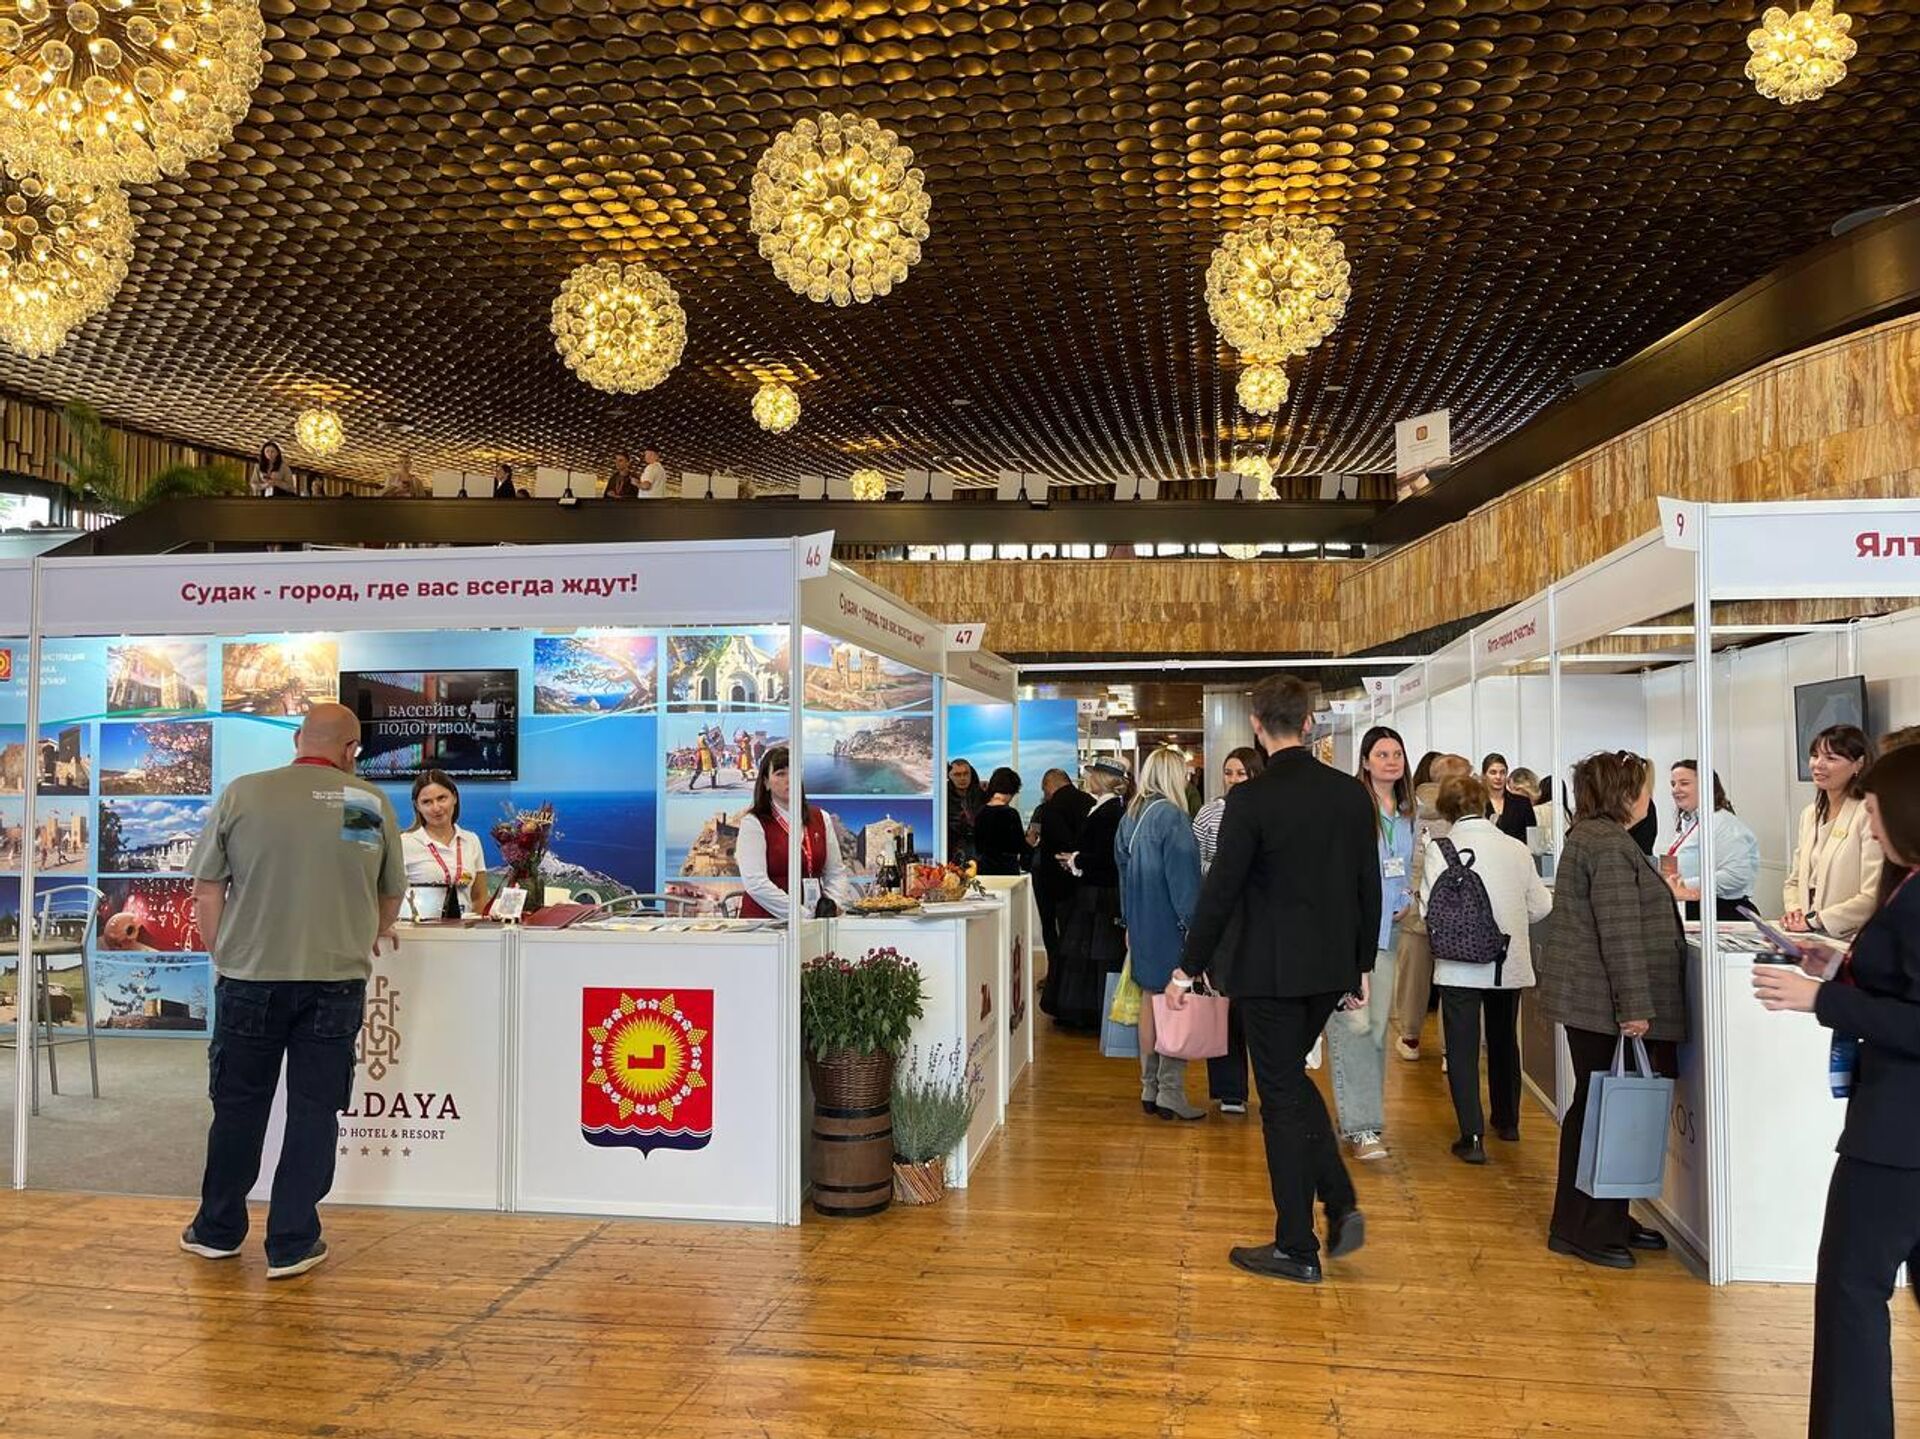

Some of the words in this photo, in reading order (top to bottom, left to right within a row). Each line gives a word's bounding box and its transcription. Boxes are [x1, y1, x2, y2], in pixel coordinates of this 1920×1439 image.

[1676, 513, 1685, 537] 9
[806, 544, 821, 567] 46
[181, 582, 257, 605] Судак
[279, 582, 359, 603] город,
[367, 582, 410, 601] где
[417, 580, 459, 597] вас
[466, 578, 554, 597] всегда
[561, 573, 638, 597] ждут!
[839, 592, 858, 617] Судак
[955, 630, 973, 644] 47
[1375, 681, 1383, 690] 8
[388, 702, 454, 717] БАССЕЙН
[379, 721, 477, 737] ПОДОГРЕВОМ
[341, 1092, 461, 1119] LDAYA
[350, 1128, 389, 1139] HOTEL
[390, 1129, 398, 1139] &
[401, 1129, 446, 1140] RESORT
